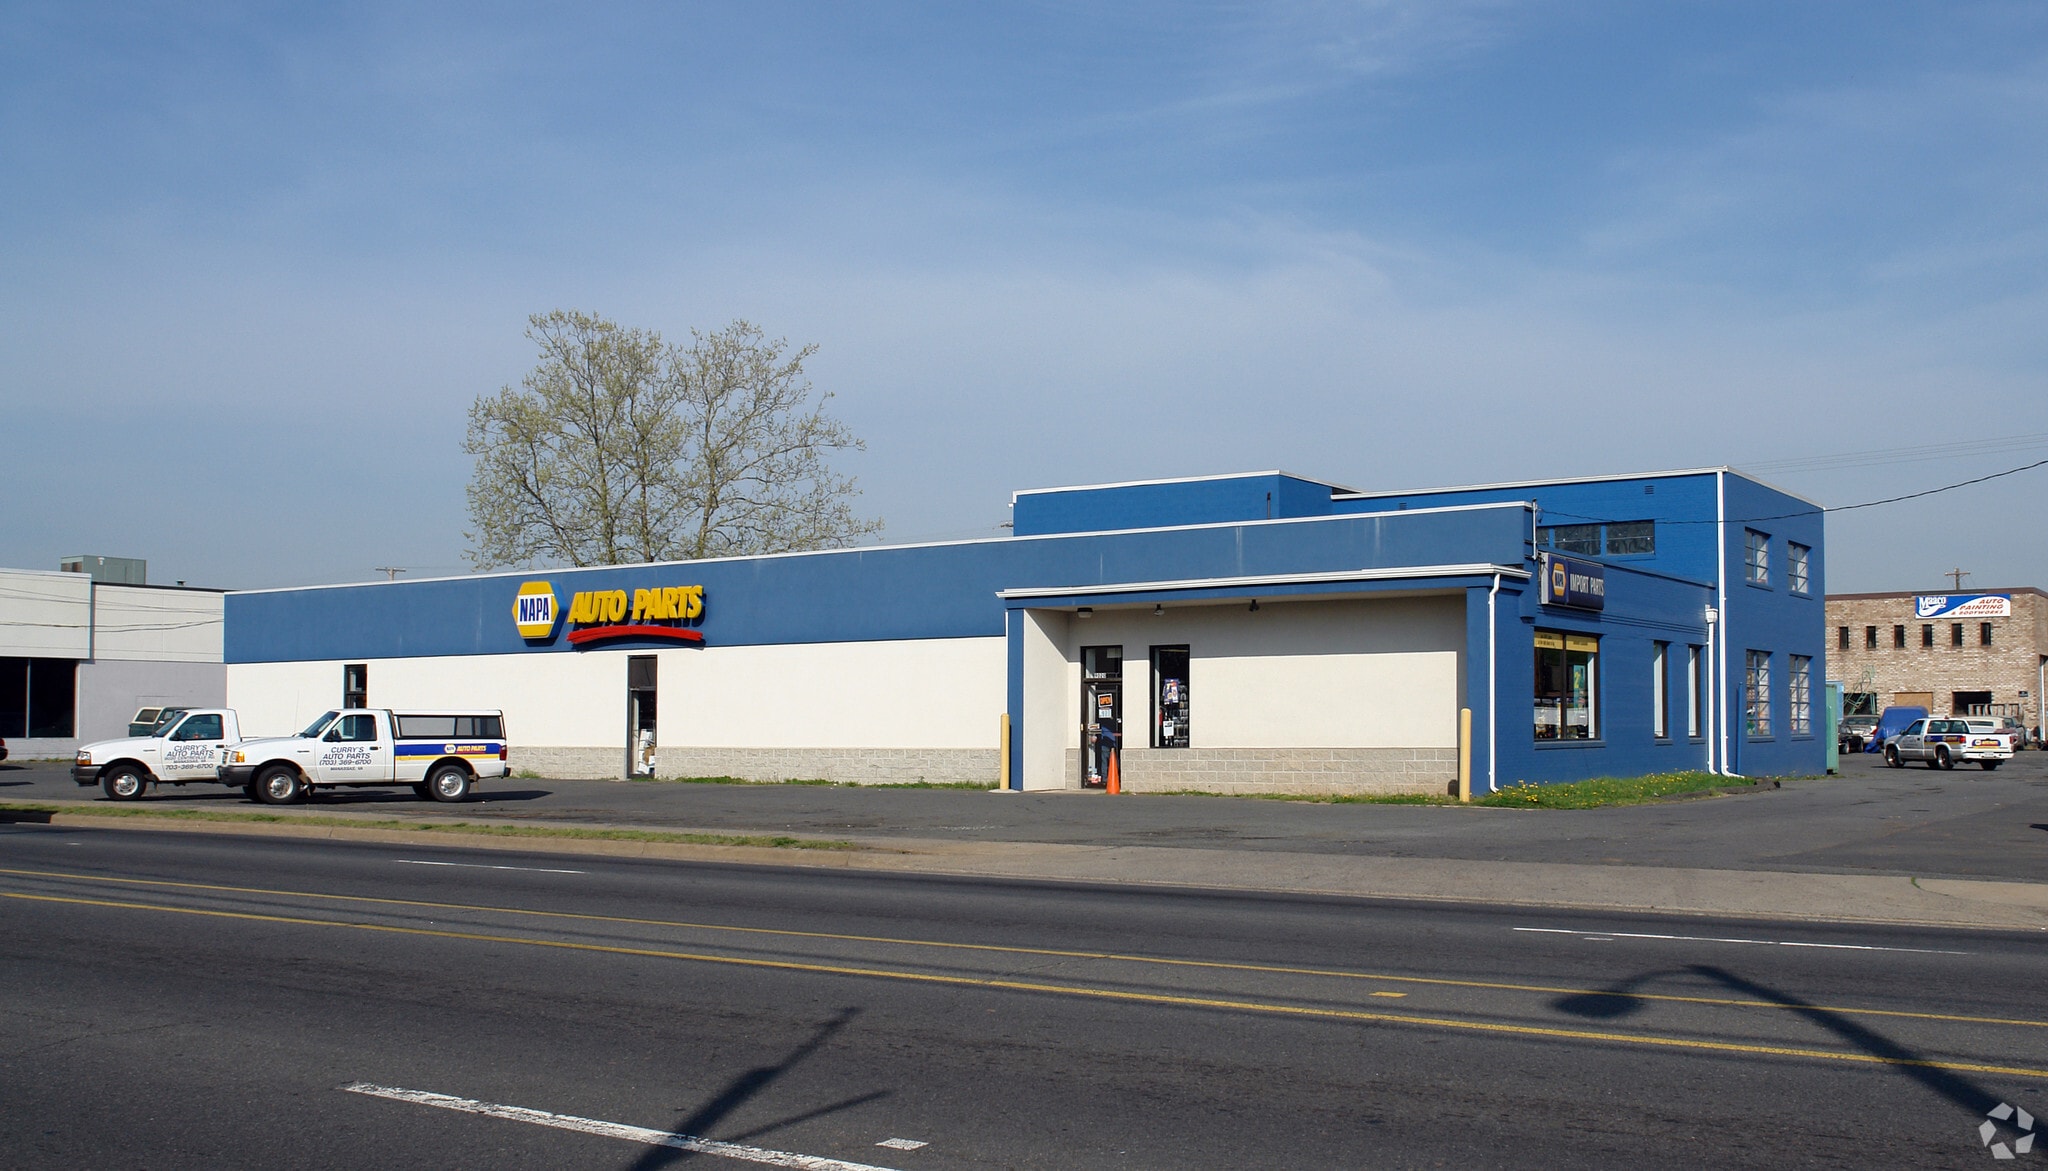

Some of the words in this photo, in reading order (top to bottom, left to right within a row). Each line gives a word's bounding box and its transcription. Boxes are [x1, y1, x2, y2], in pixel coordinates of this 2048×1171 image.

[1554, 571, 1564, 587] NAPA
[1570, 573, 1589, 593] IMPORT
[1590, 576, 1604, 597] PARTS
[519, 597, 550, 622] NAPA
[567, 589, 628, 623] AUTO
[632, 585, 704, 620] PARTS
[1919, 596, 1946, 610] Maaco
[346, 752, 371, 760] PARTS
